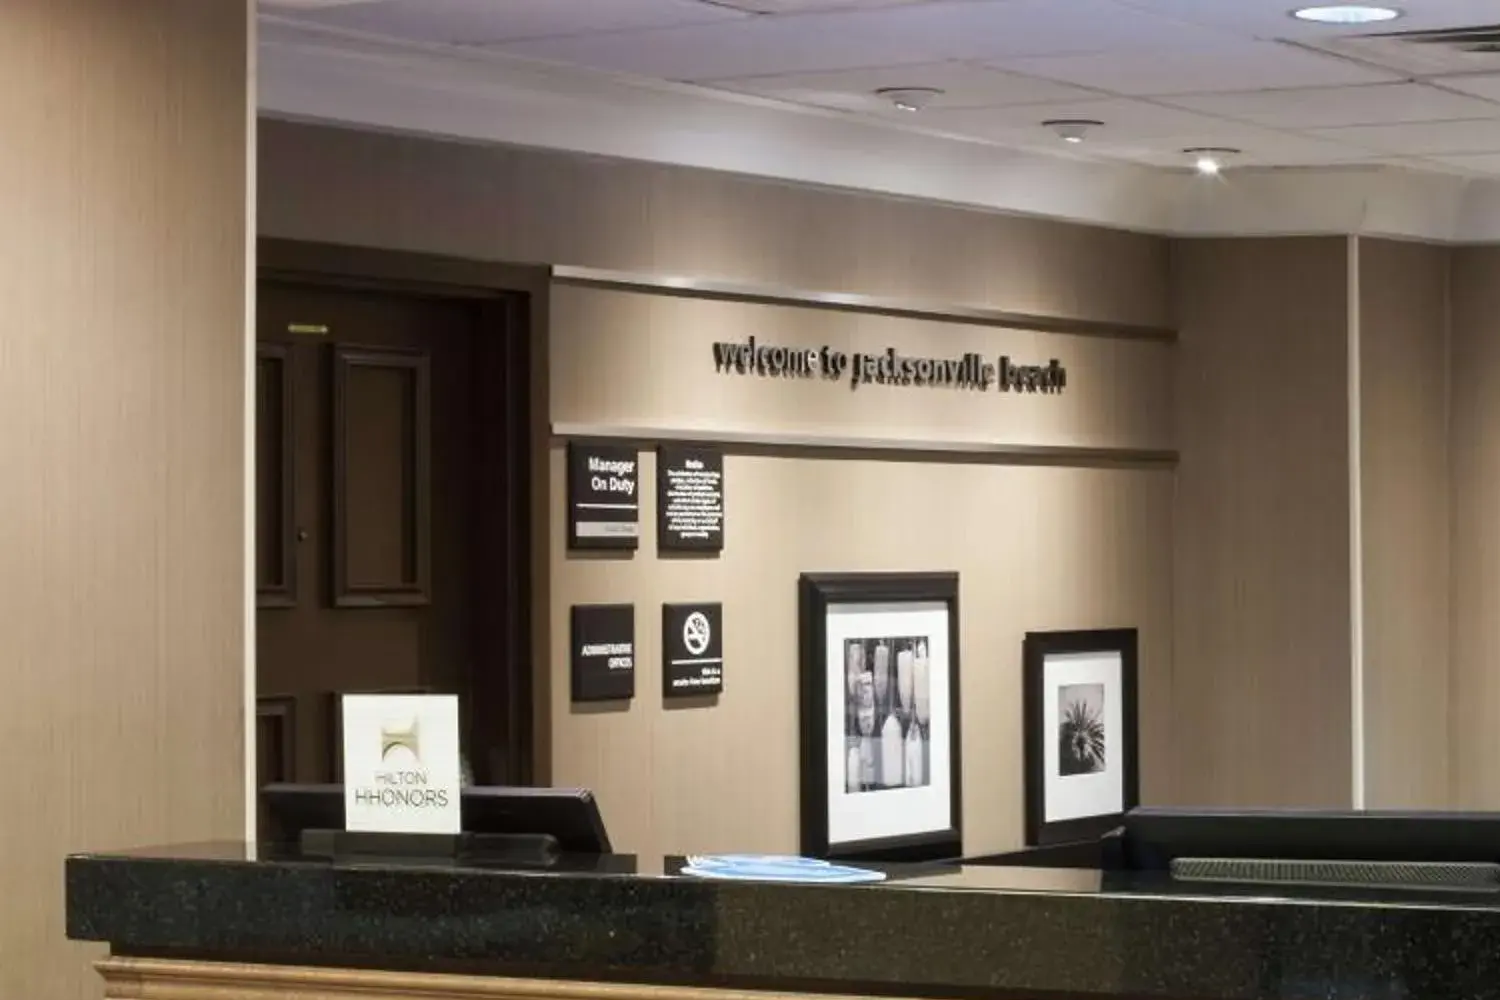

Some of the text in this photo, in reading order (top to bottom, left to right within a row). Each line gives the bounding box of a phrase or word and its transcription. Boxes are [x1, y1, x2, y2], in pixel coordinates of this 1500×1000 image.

[712, 336, 818, 379] welcome
[820, 346, 846, 381] to
[850, 347, 996, 392] jacksonville
[588, 457, 635, 476] Manager
[591, 476, 635, 495] On Duty
[374, 770, 428, 785] HILTON
[355, 788, 449, 808] HHONORS
